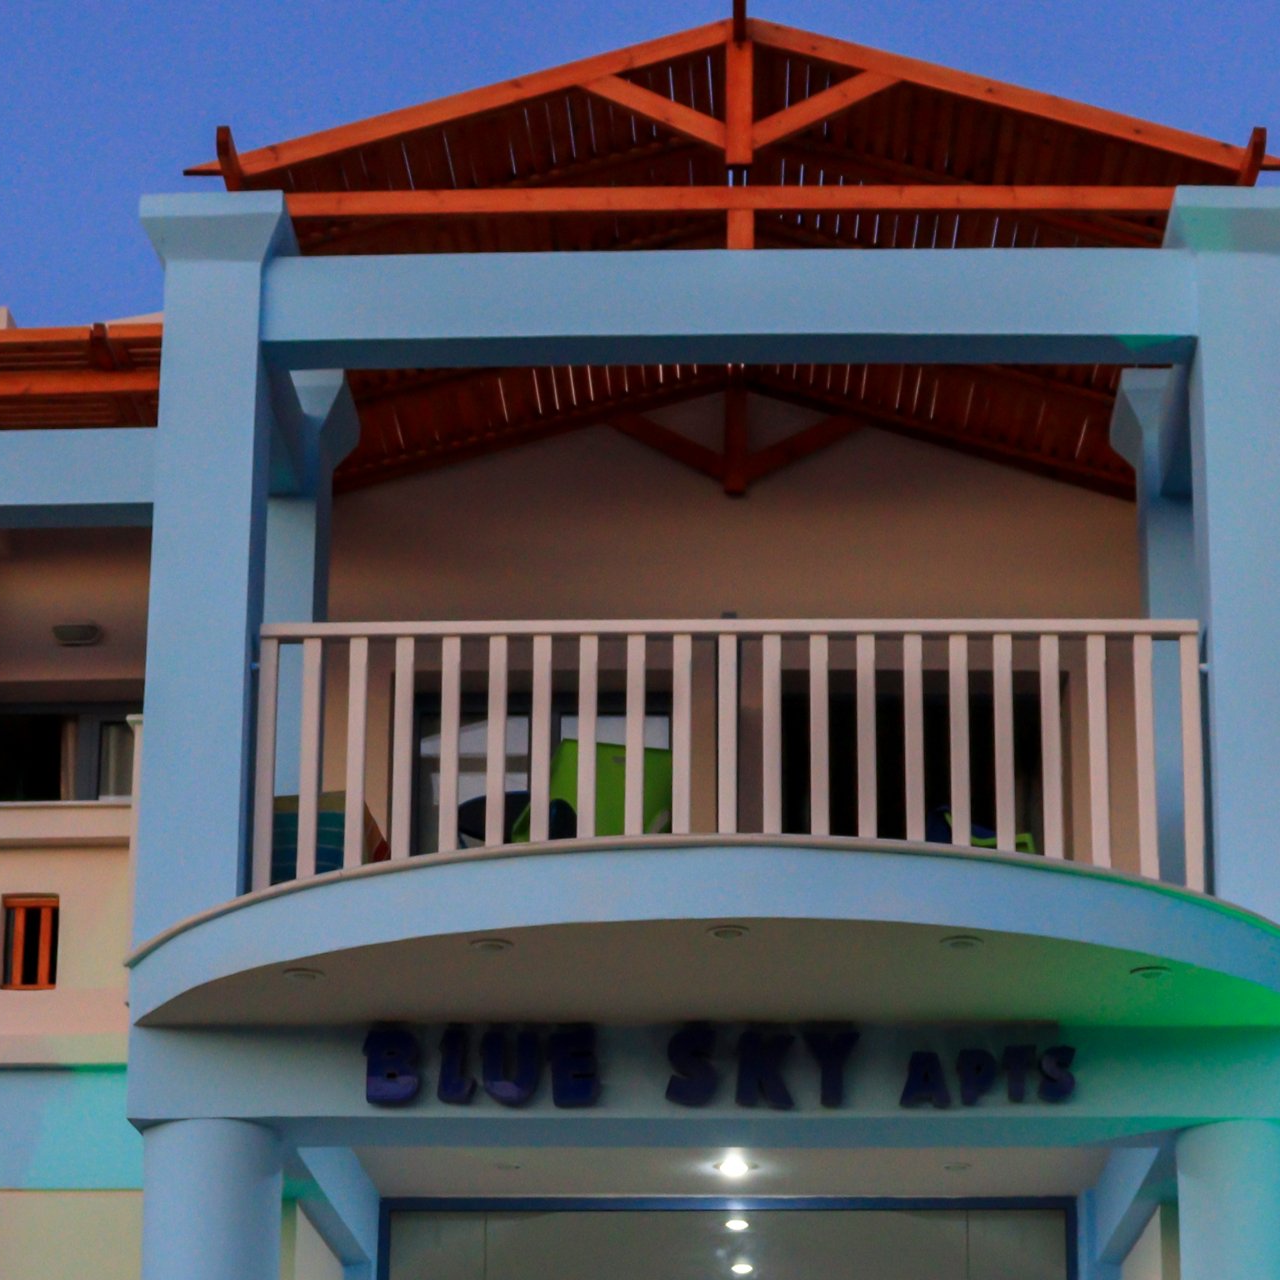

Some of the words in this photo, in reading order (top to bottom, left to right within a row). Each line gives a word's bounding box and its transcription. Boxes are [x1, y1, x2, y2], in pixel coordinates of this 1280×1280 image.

[362, 1022, 600, 1107] BLUE
[666, 1021, 859, 1109] SKY
[900, 1045, 1076, 1109] APTS
